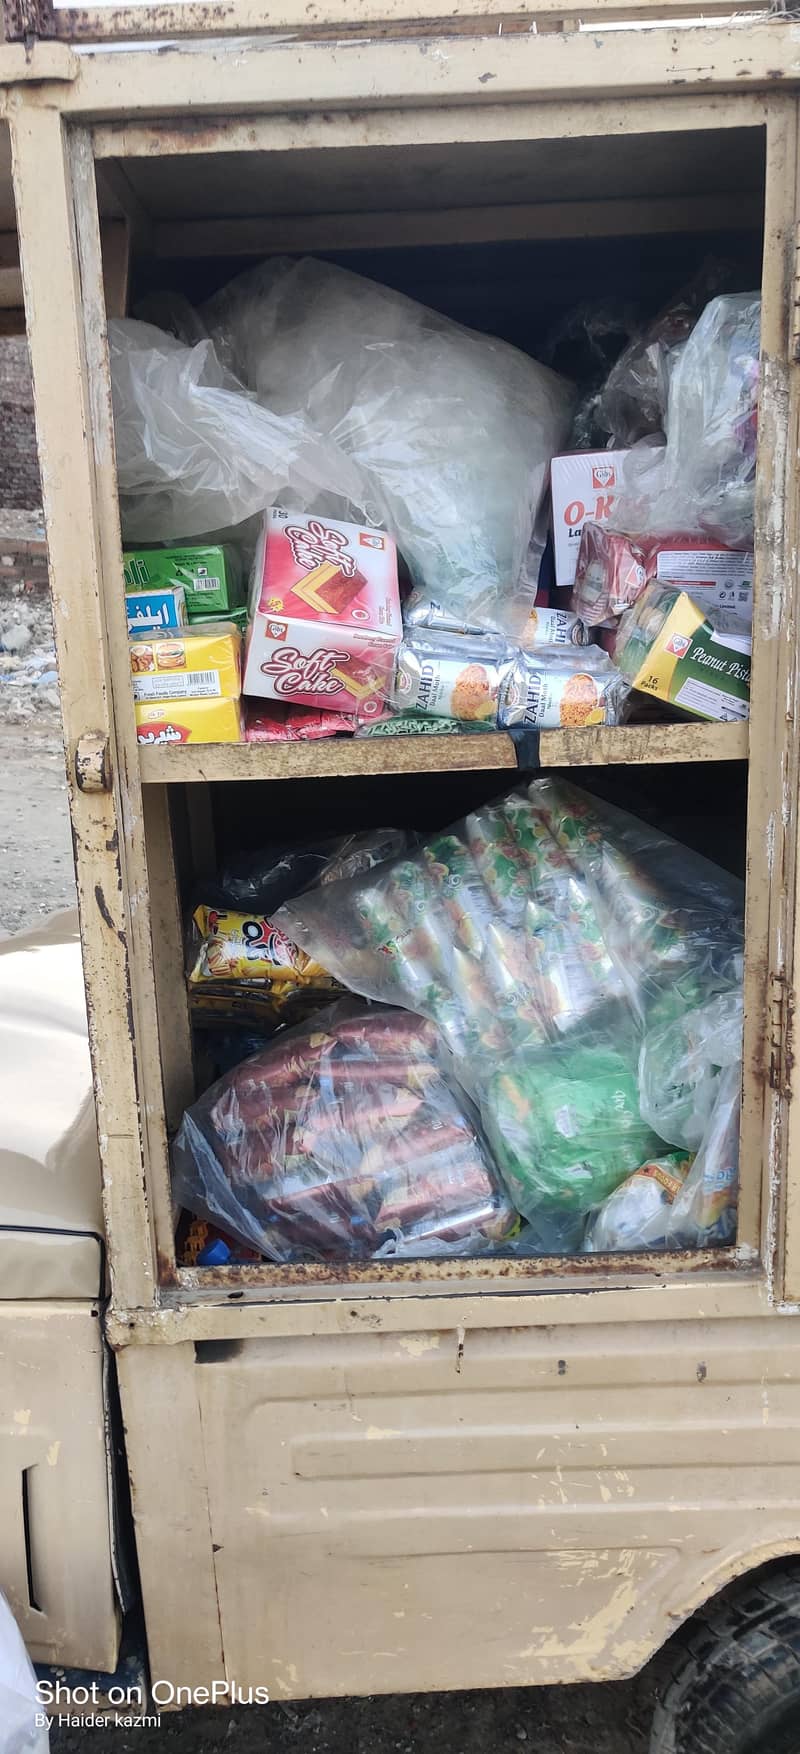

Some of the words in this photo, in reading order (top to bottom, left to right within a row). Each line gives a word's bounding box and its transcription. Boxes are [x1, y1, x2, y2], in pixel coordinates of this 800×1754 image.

[563, 495, 615, 526] O-K
[567, 527, 582, 538] La
[284, 526, 328, 572] Cake
[308, 521, 356, 577] Soft
[555, 612, 568, 643] ZAHI
[260, 646, 350, 681] Soft
[690, 646, 728, 671] Peanut
[274, 672, 346, 696] Cake
[415, 665, 434, 710] ZAHID
[648, 675, 660, 685] 16
[523, 674, 542, 724] ZAHID
